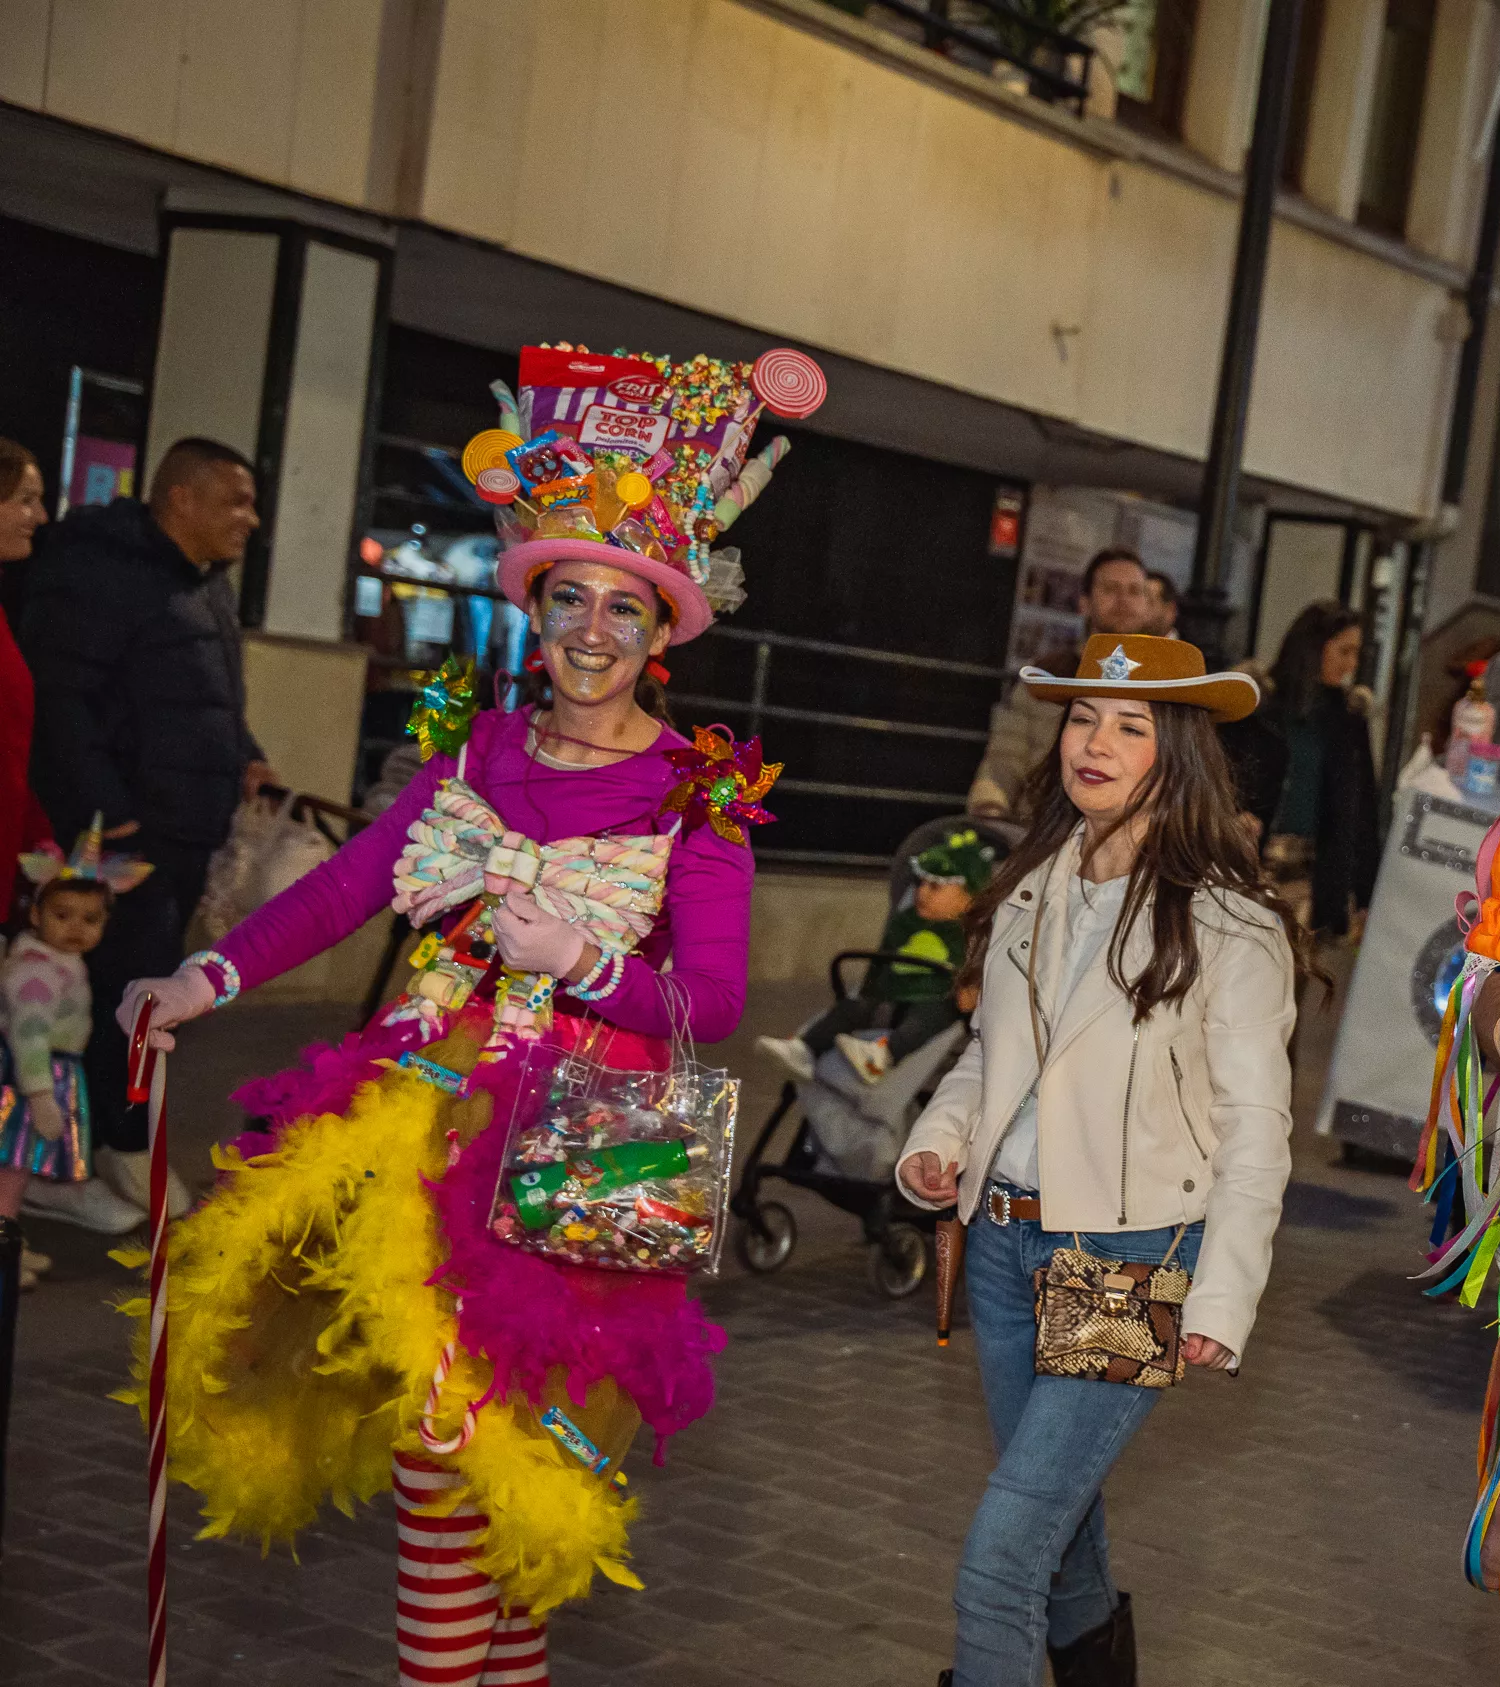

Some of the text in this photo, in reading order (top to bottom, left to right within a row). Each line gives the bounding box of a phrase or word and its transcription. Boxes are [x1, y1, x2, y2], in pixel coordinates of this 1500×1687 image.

[615, 382, 661, 397] FRIT
[600, 411, 657, 430] TOP
[595, 422, 653, 443] CORN
